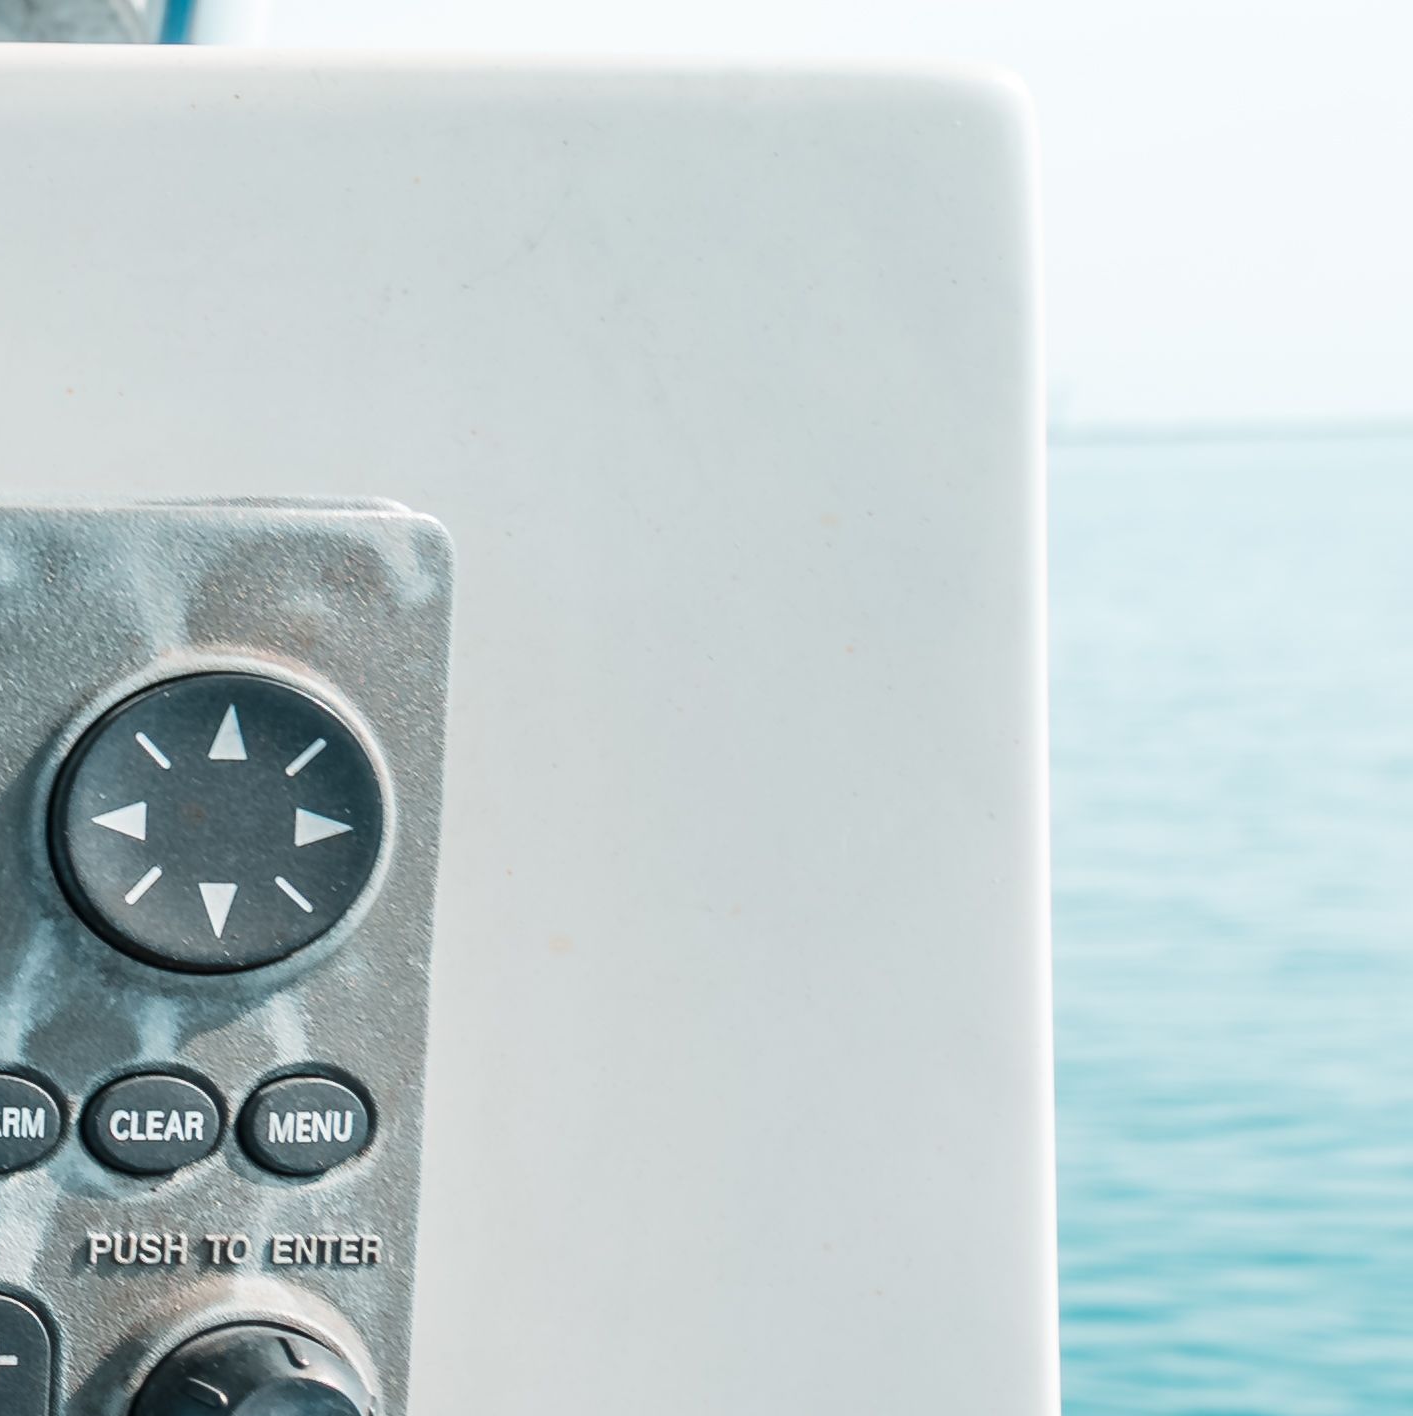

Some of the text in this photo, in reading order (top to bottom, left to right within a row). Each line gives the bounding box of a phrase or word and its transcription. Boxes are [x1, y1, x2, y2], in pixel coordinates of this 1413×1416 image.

[109, 1109, 204, 1142] CLEAR
[268, 1110, 354, 1144] MENU
[87, 1232, 385, 1267] PUSH TO ENTER
